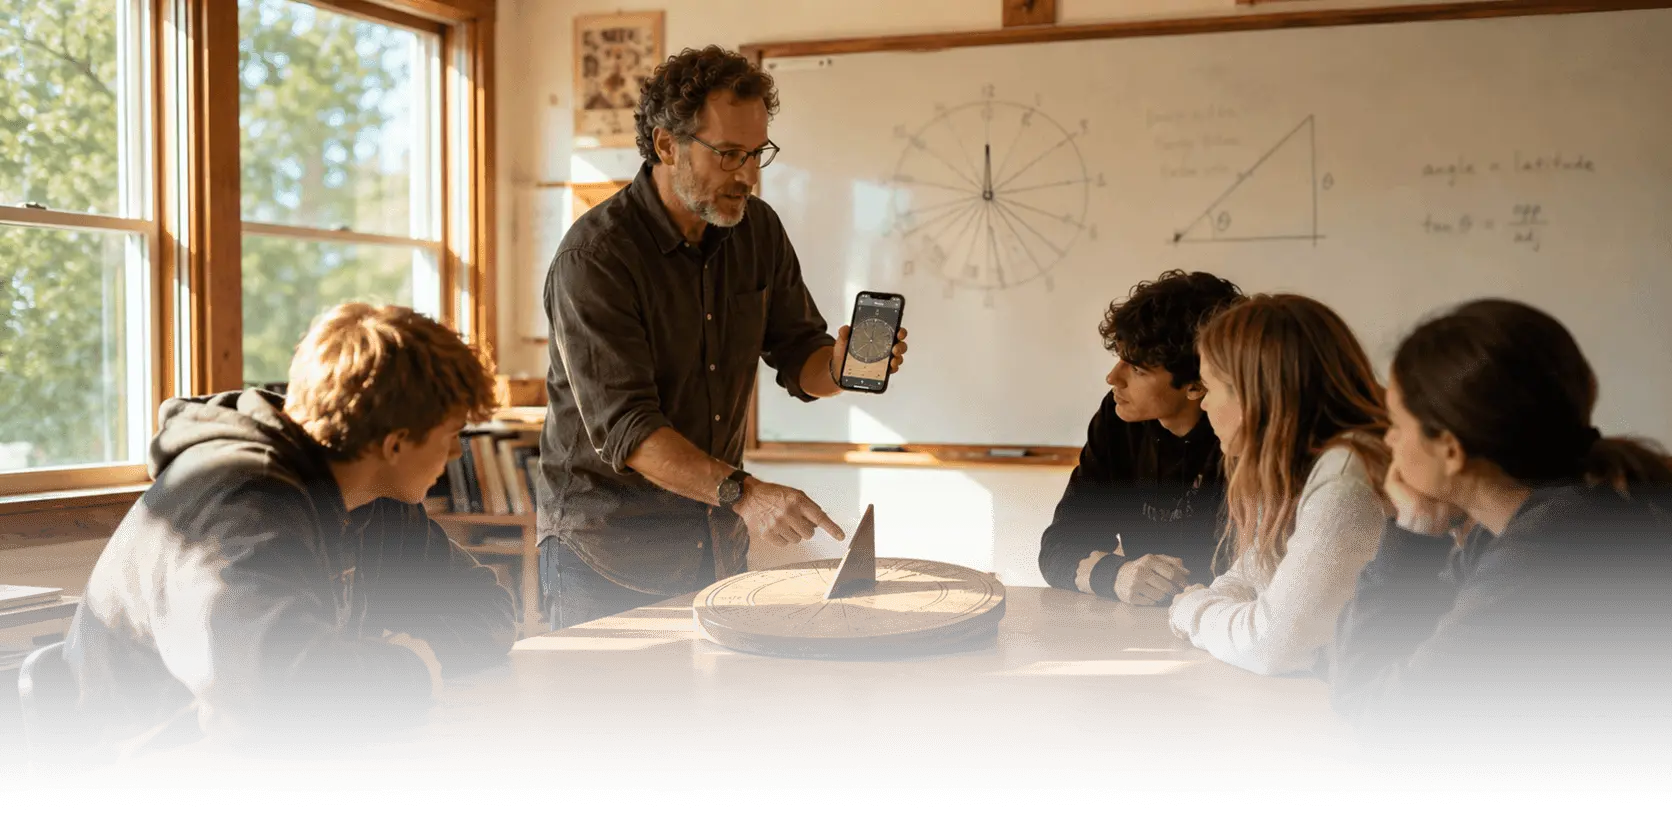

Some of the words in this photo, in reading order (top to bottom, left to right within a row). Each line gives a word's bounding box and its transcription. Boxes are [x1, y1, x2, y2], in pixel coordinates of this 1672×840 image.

[1422, 154, 1475, 187] angle
[1514, 149, 1595, 172] latitude
[1422, 213, 1452, 233] tan
